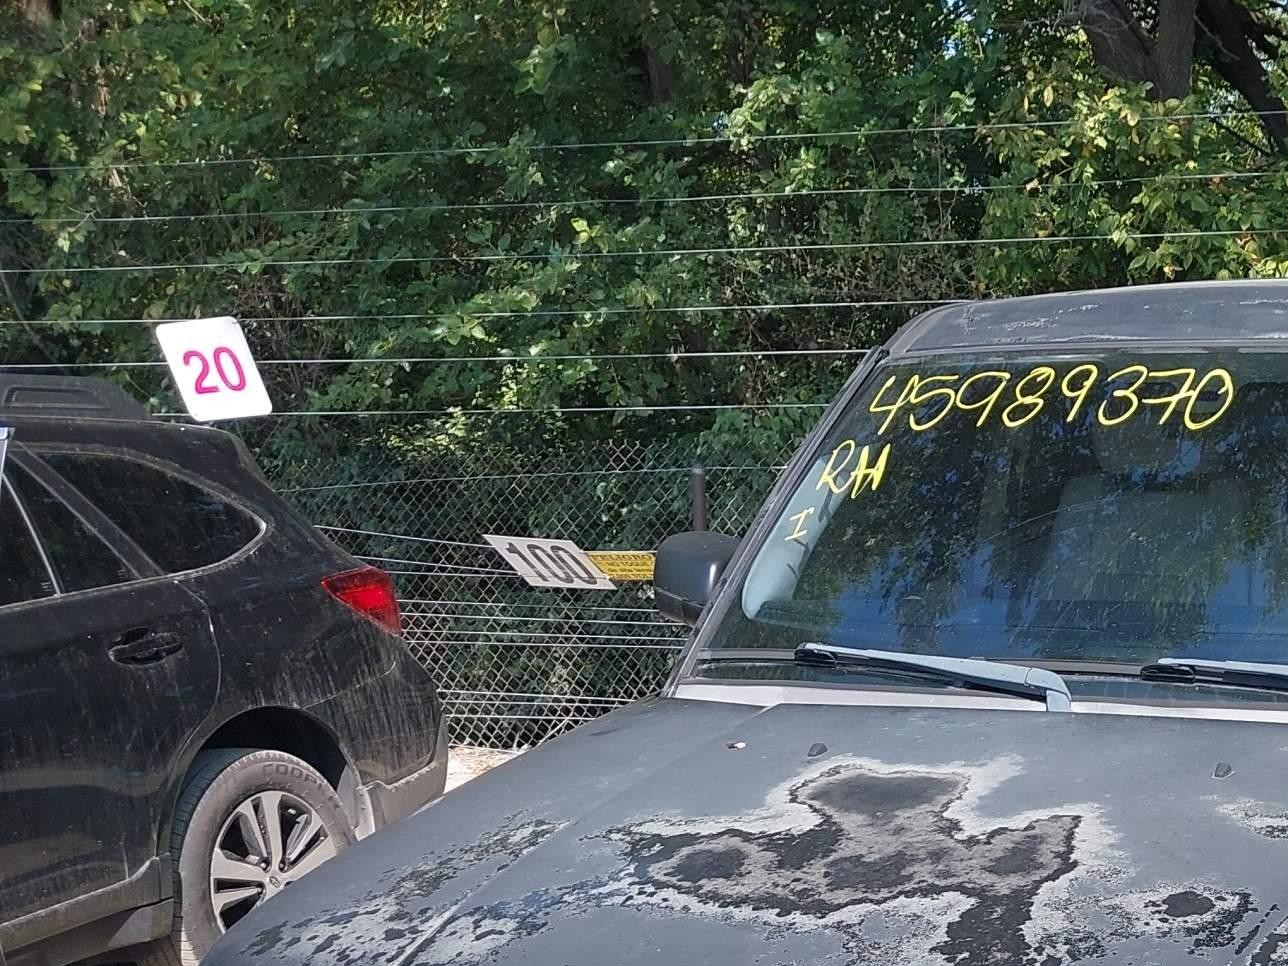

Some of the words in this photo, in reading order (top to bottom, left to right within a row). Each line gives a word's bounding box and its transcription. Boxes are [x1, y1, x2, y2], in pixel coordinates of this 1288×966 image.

[183, 346, 246, 394] 20
[869, 364, 1234, 436] 45989370
[815, 439, 891, 499] RH
[505, 542, 598, 585] 100
